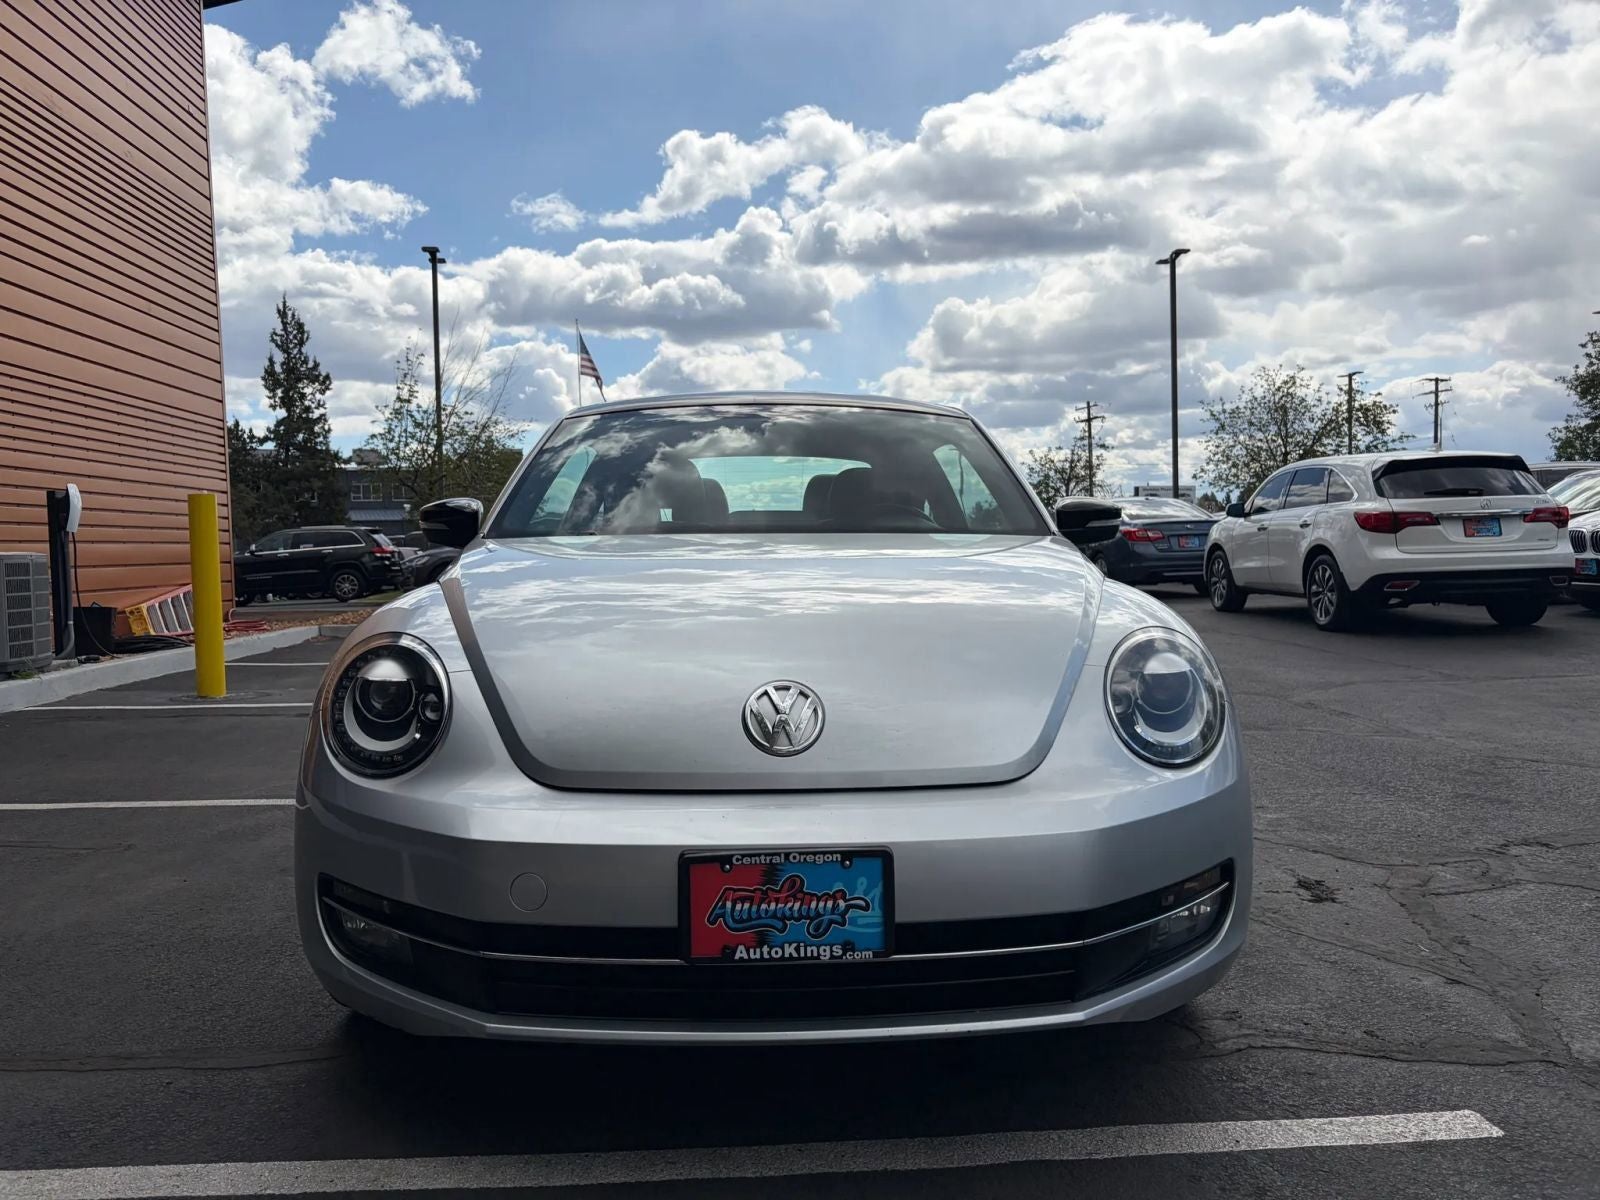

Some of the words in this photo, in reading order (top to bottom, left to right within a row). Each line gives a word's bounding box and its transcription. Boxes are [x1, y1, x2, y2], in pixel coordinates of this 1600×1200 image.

[744, 682, 823, 754] VW
[732, 852, 785, 865] Central
[789, 852, 842, 864] Oregon
[734, 943, 873, 960] AutoKings.com
